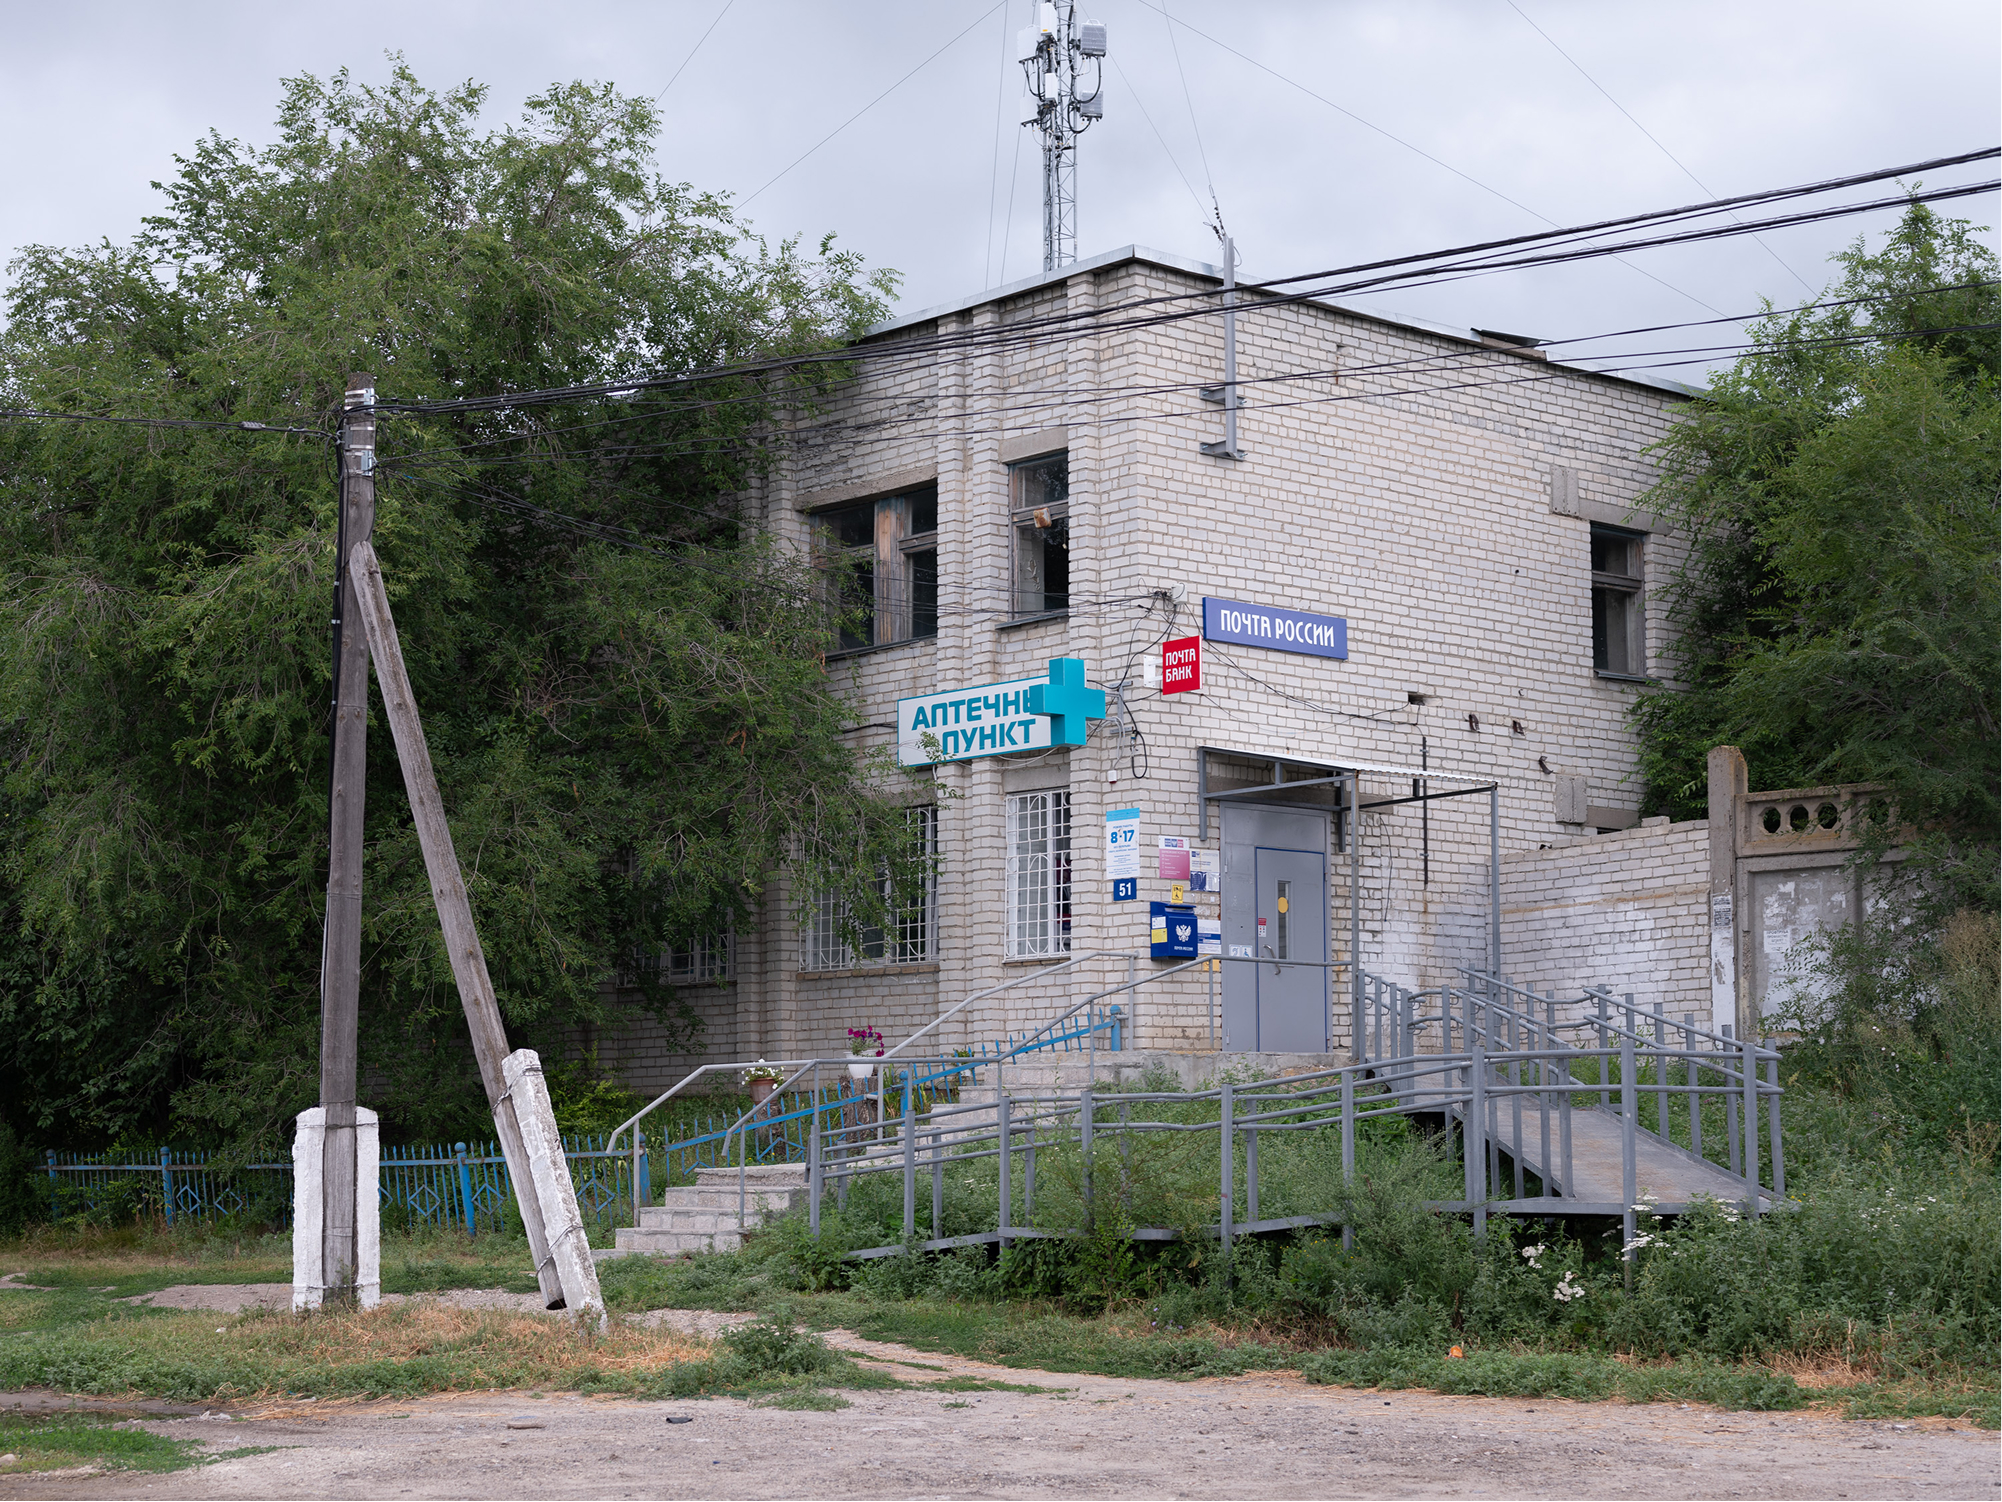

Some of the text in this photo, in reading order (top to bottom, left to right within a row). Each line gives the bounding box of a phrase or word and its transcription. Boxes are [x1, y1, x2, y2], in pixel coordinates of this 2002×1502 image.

[1220, 609, 1335, 648] ПОЧТА РОССИИ
[1165, 648, 1196, 666] ПОЧТА
[1165, 665, 1193, 683] БАНК
[942, 718, 1036, 756] ПУНКТ
[1119, 882, 1132, 897] 51
